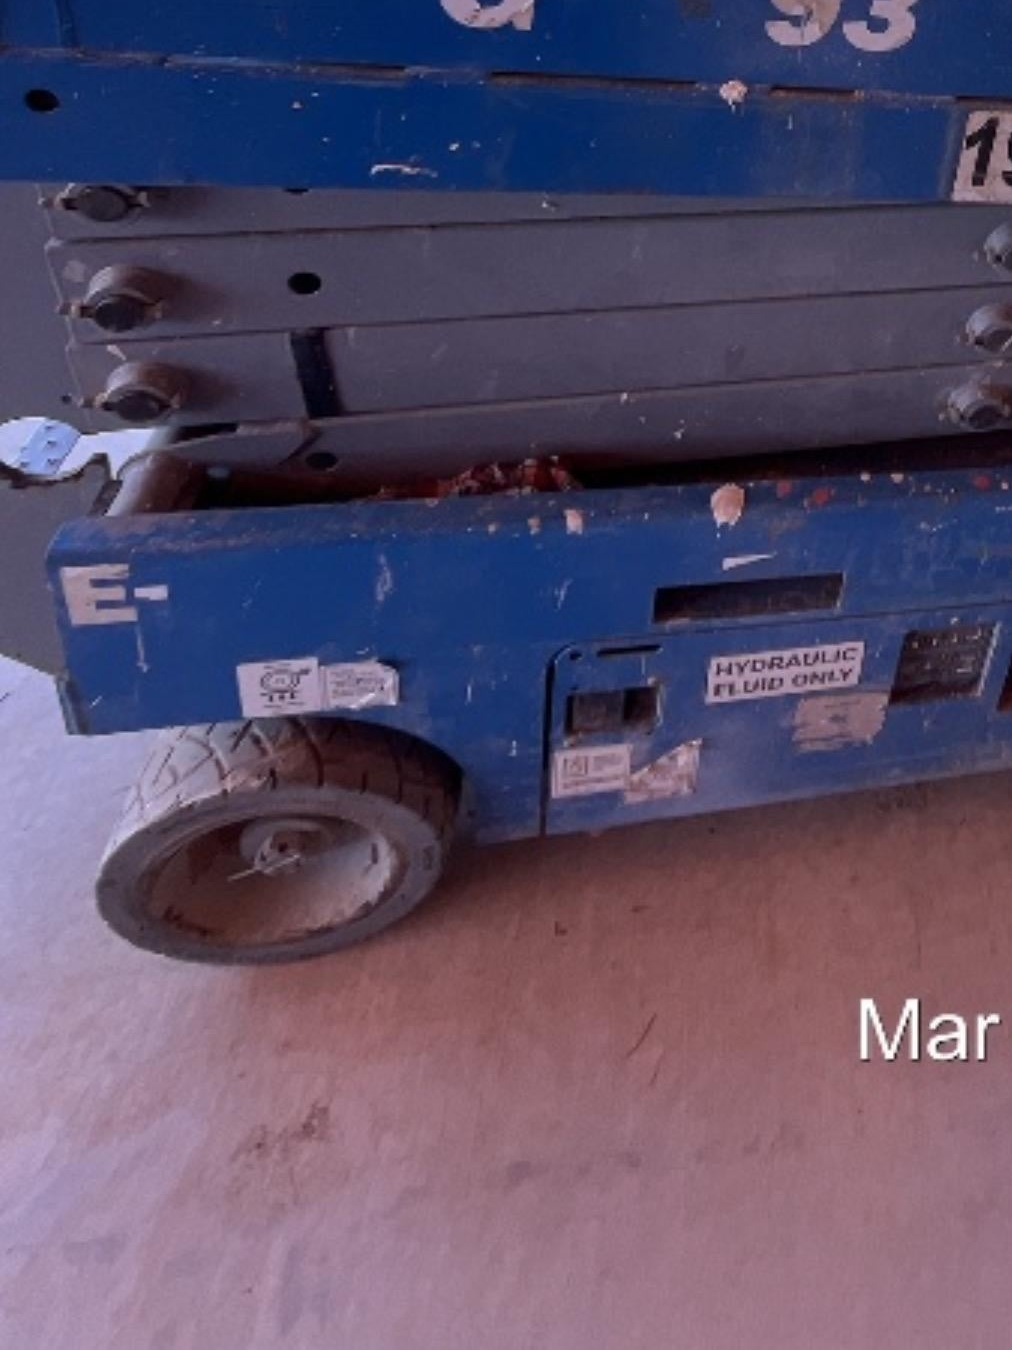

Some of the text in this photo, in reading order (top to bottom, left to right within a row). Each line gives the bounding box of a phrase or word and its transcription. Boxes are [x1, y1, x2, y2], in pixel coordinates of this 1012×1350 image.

[716, 648, 858, 677] HYDRAULIC
[713, 668, 852, 698] FLUID ONLY
